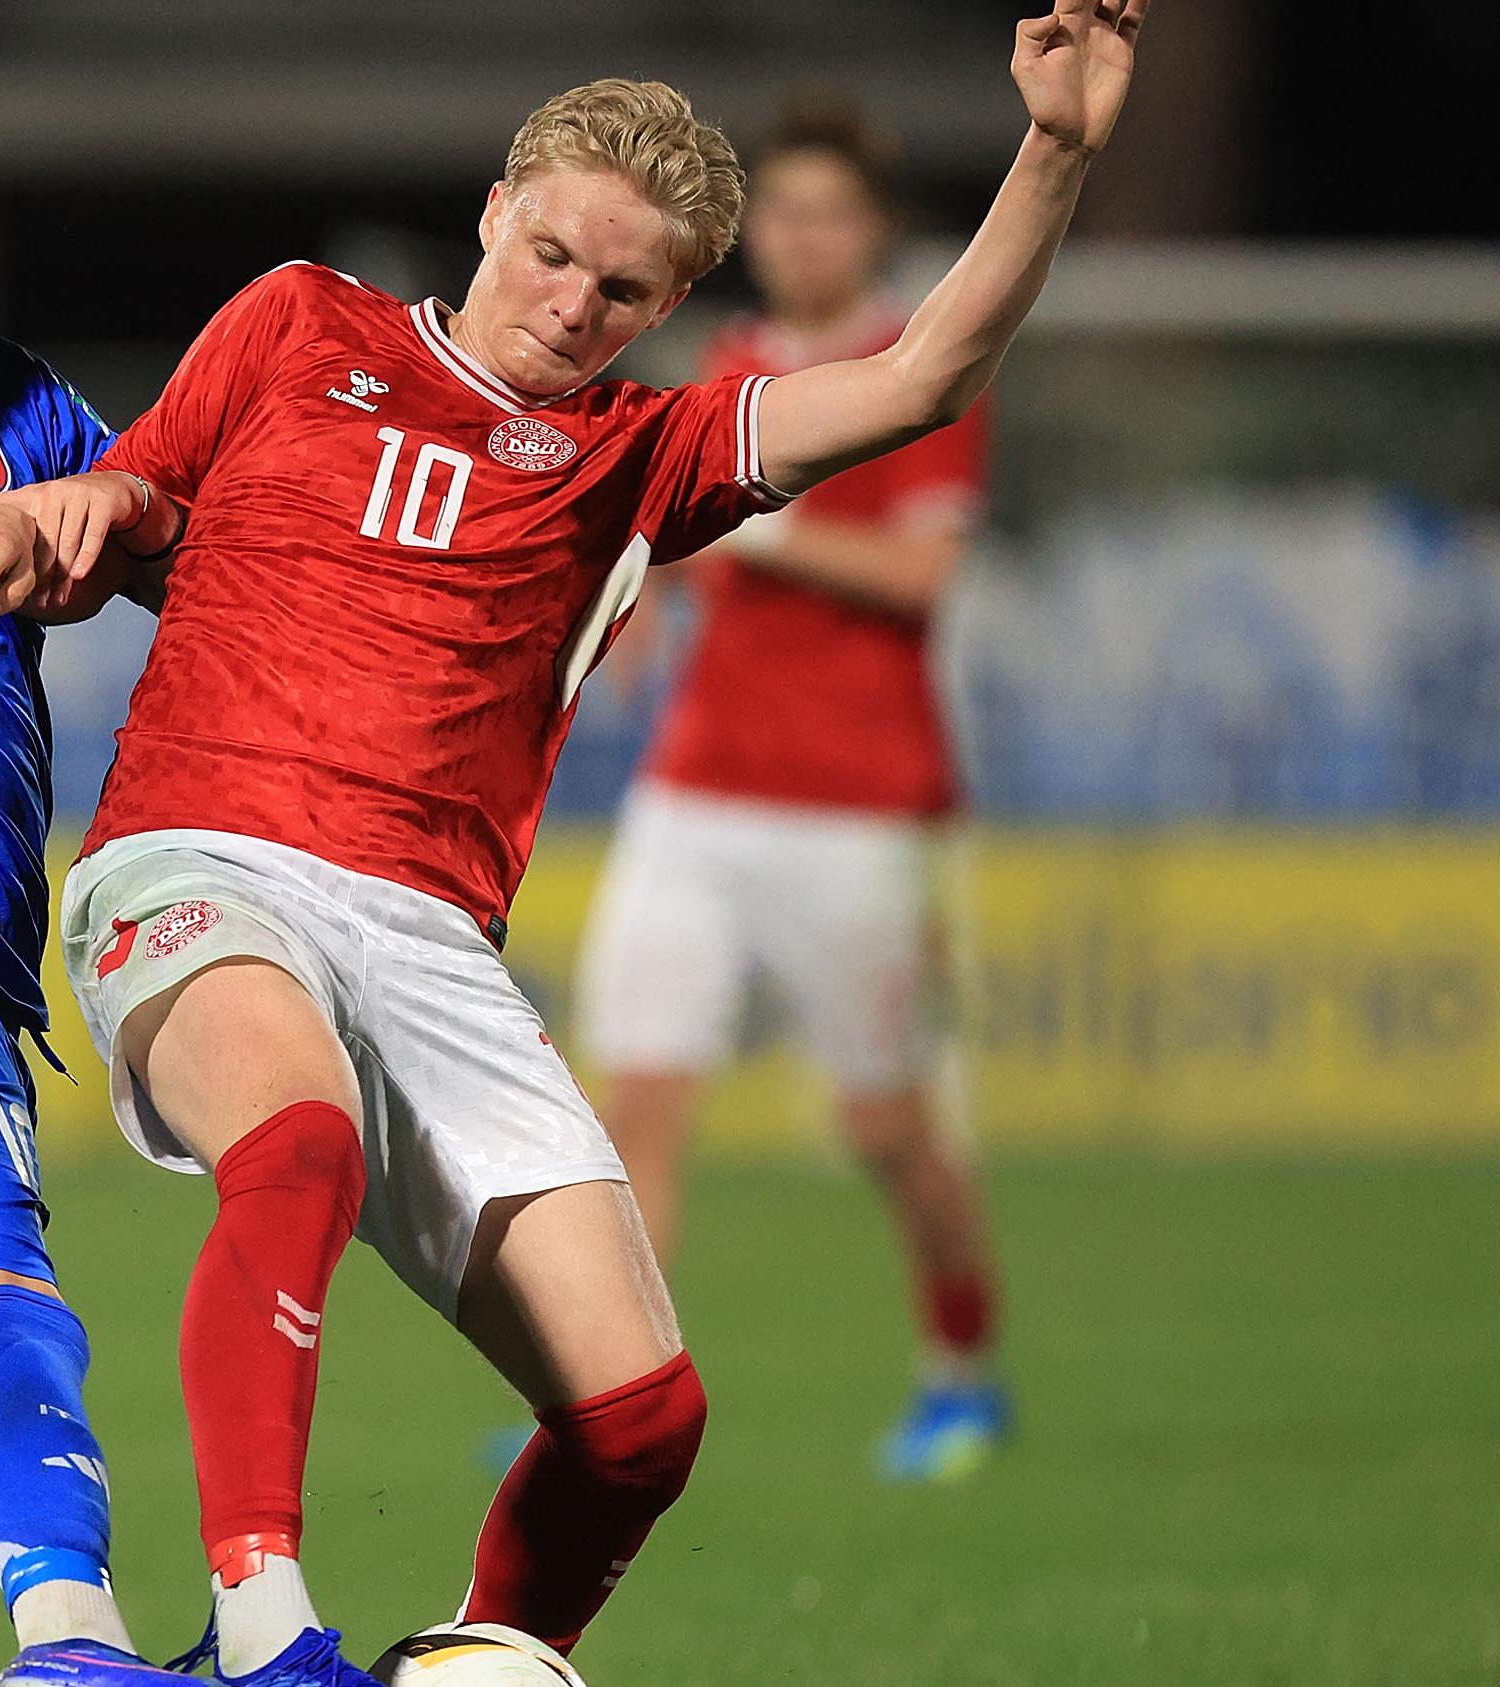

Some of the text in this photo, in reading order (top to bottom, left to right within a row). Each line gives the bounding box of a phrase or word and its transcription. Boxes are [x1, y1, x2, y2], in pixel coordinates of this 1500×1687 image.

[326, 387, 379, 412] hummel
[505, 437, 559, 455] DBU
[359, 426, 475, 550] 10
[158, 909, 205, 947] DBU
